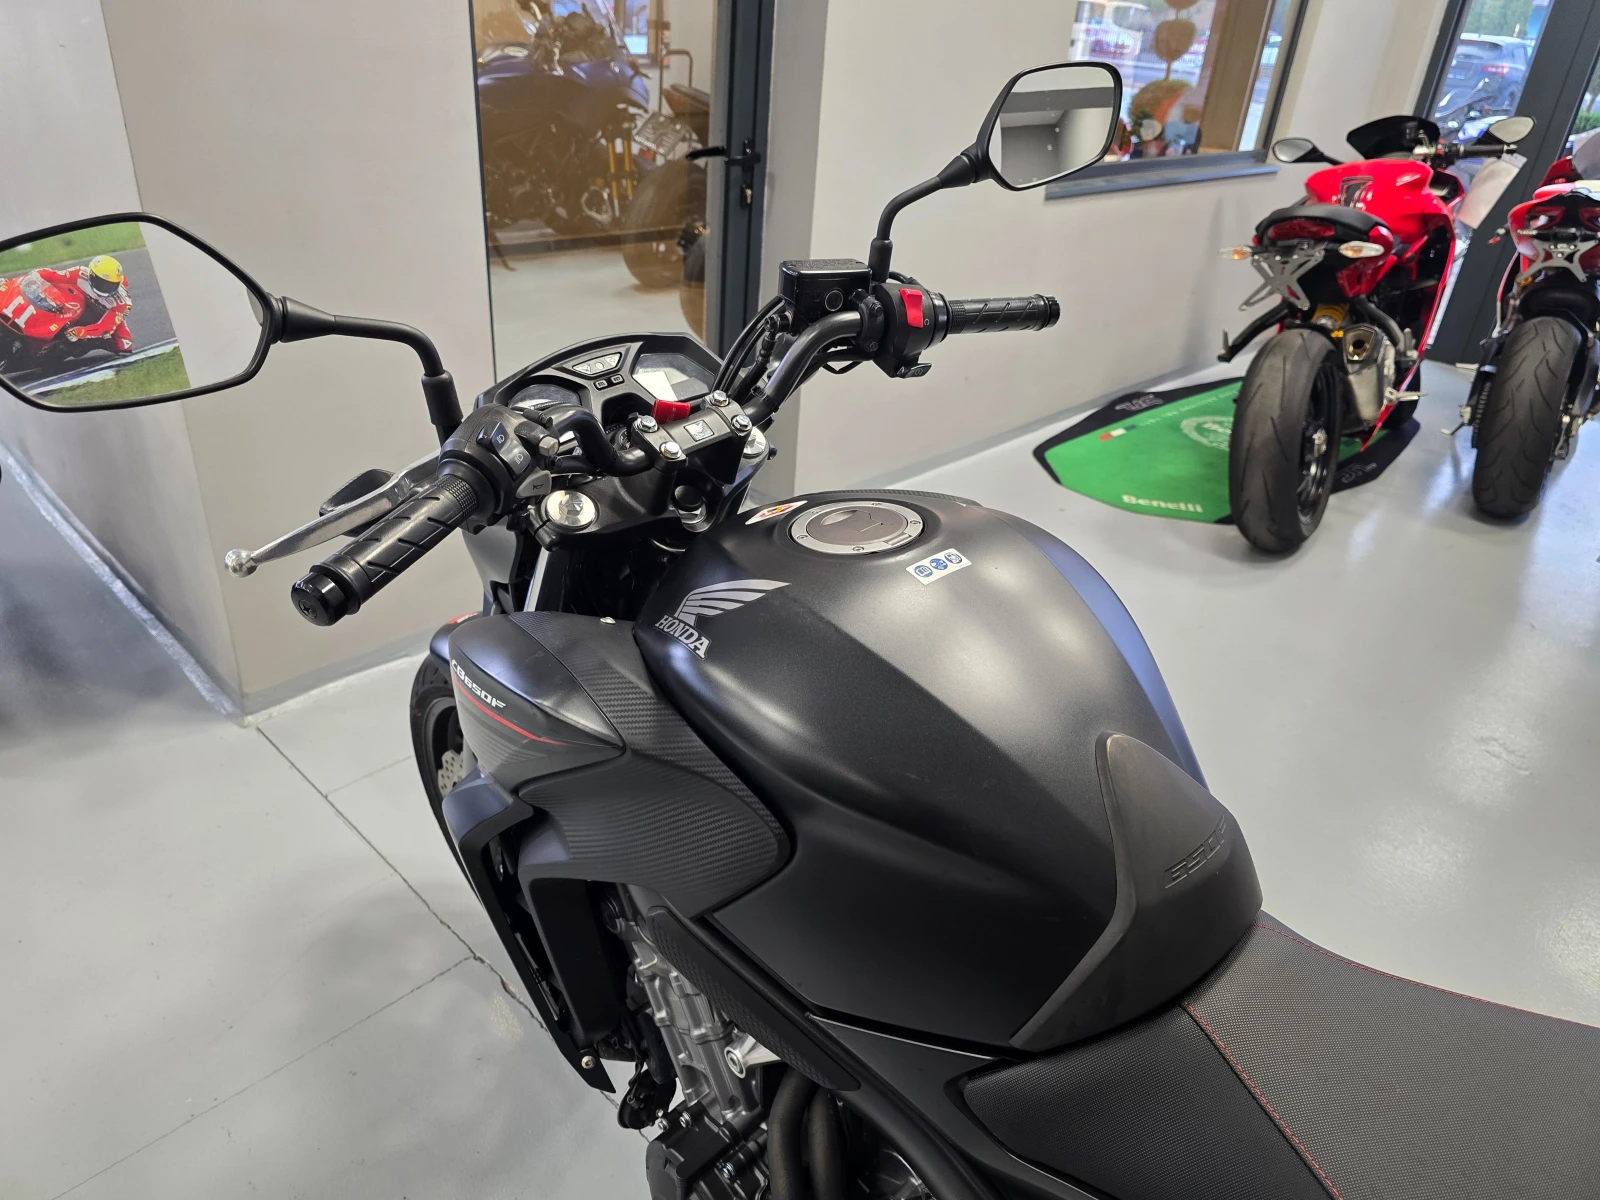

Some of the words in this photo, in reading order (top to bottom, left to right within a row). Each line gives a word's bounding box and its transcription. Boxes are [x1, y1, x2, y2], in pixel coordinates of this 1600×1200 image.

[1121, 494, 1204, 513] Benelli
[654, 614, 710, 659] HONDA
[451, 659, 507, 708] CB650F
